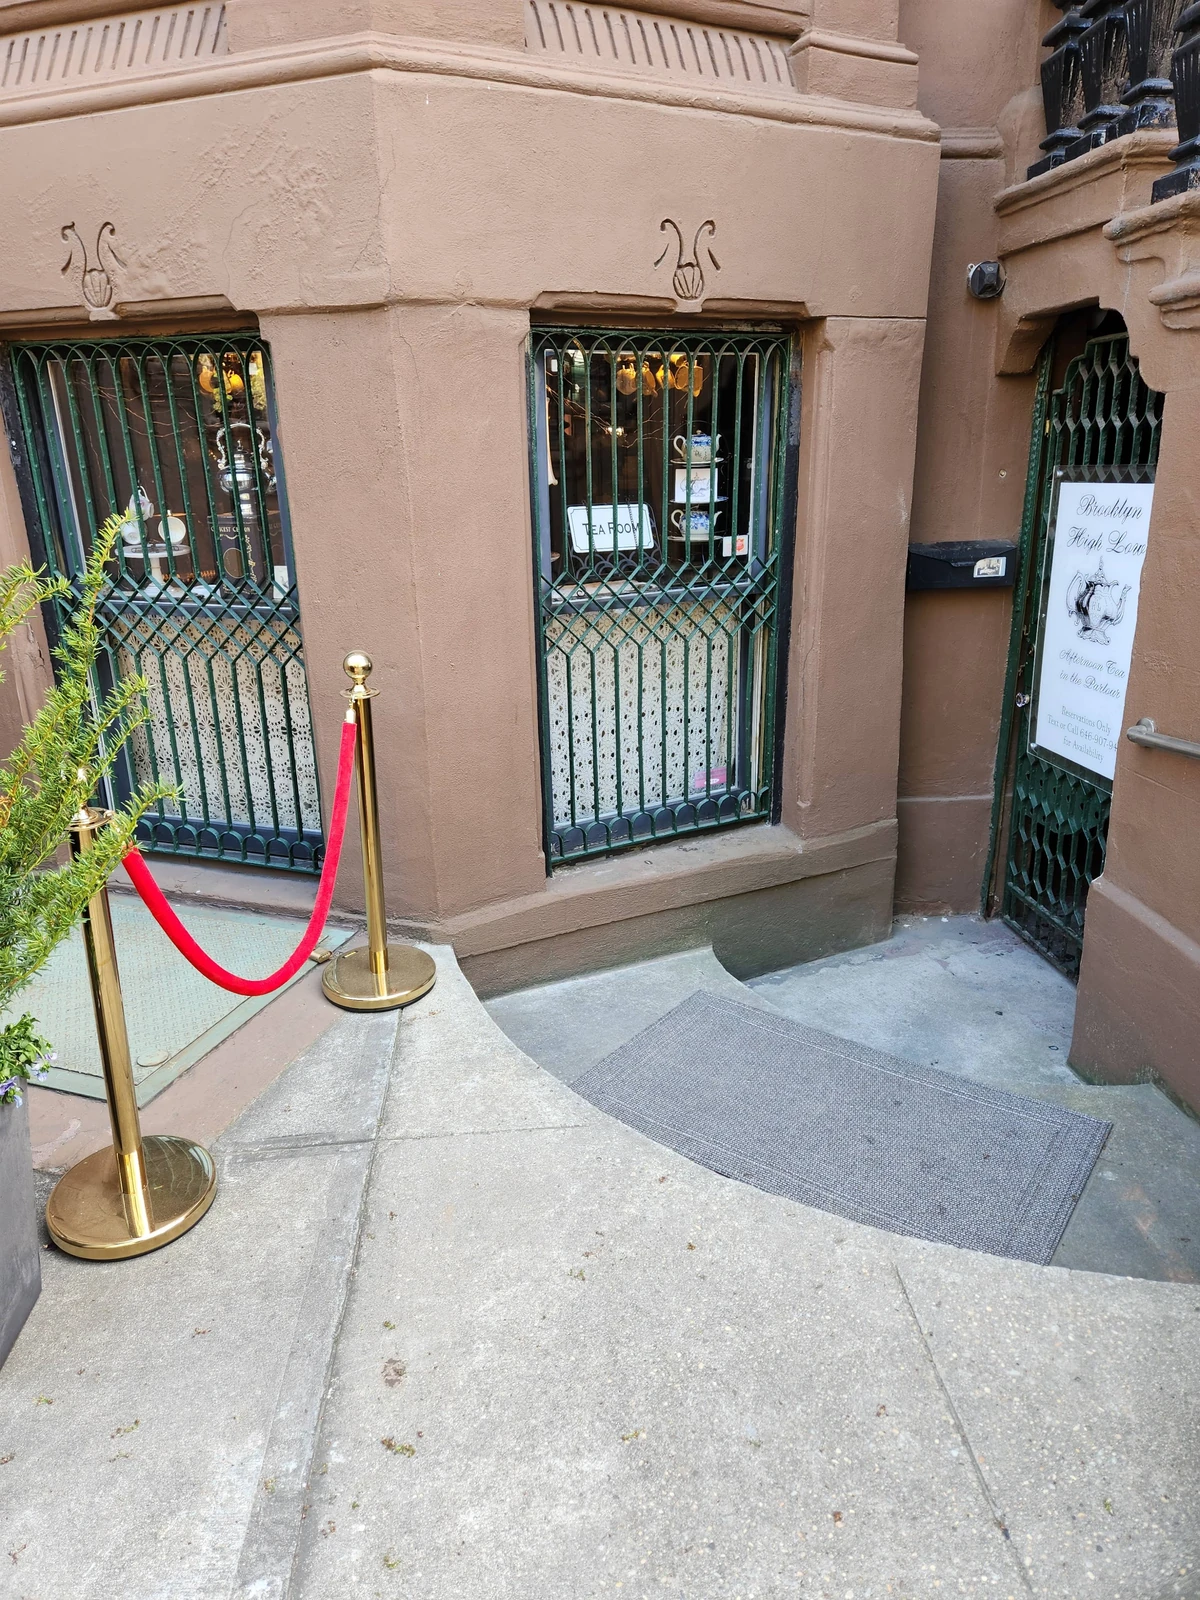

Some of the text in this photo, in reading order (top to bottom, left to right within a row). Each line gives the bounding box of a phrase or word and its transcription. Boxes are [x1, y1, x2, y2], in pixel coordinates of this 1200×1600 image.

[1076, 494, 1143, 525] Brooklyn
[582, 523, 606, 536] TEA
[1066, 526, 1146, 556] High Low
[1059, 648, 1126, 679] Afternoon Tea
[1059, 669, 1121, 699] in the Parlour
[1047, 713, 1060, 728] Text
[1060, 722, 1067, 730] or
[1067, 722, 1079, 736] Call
[1061, 705, 1112, 736] Reservations Only
[1063, 735, 1104, 764] for Availability
